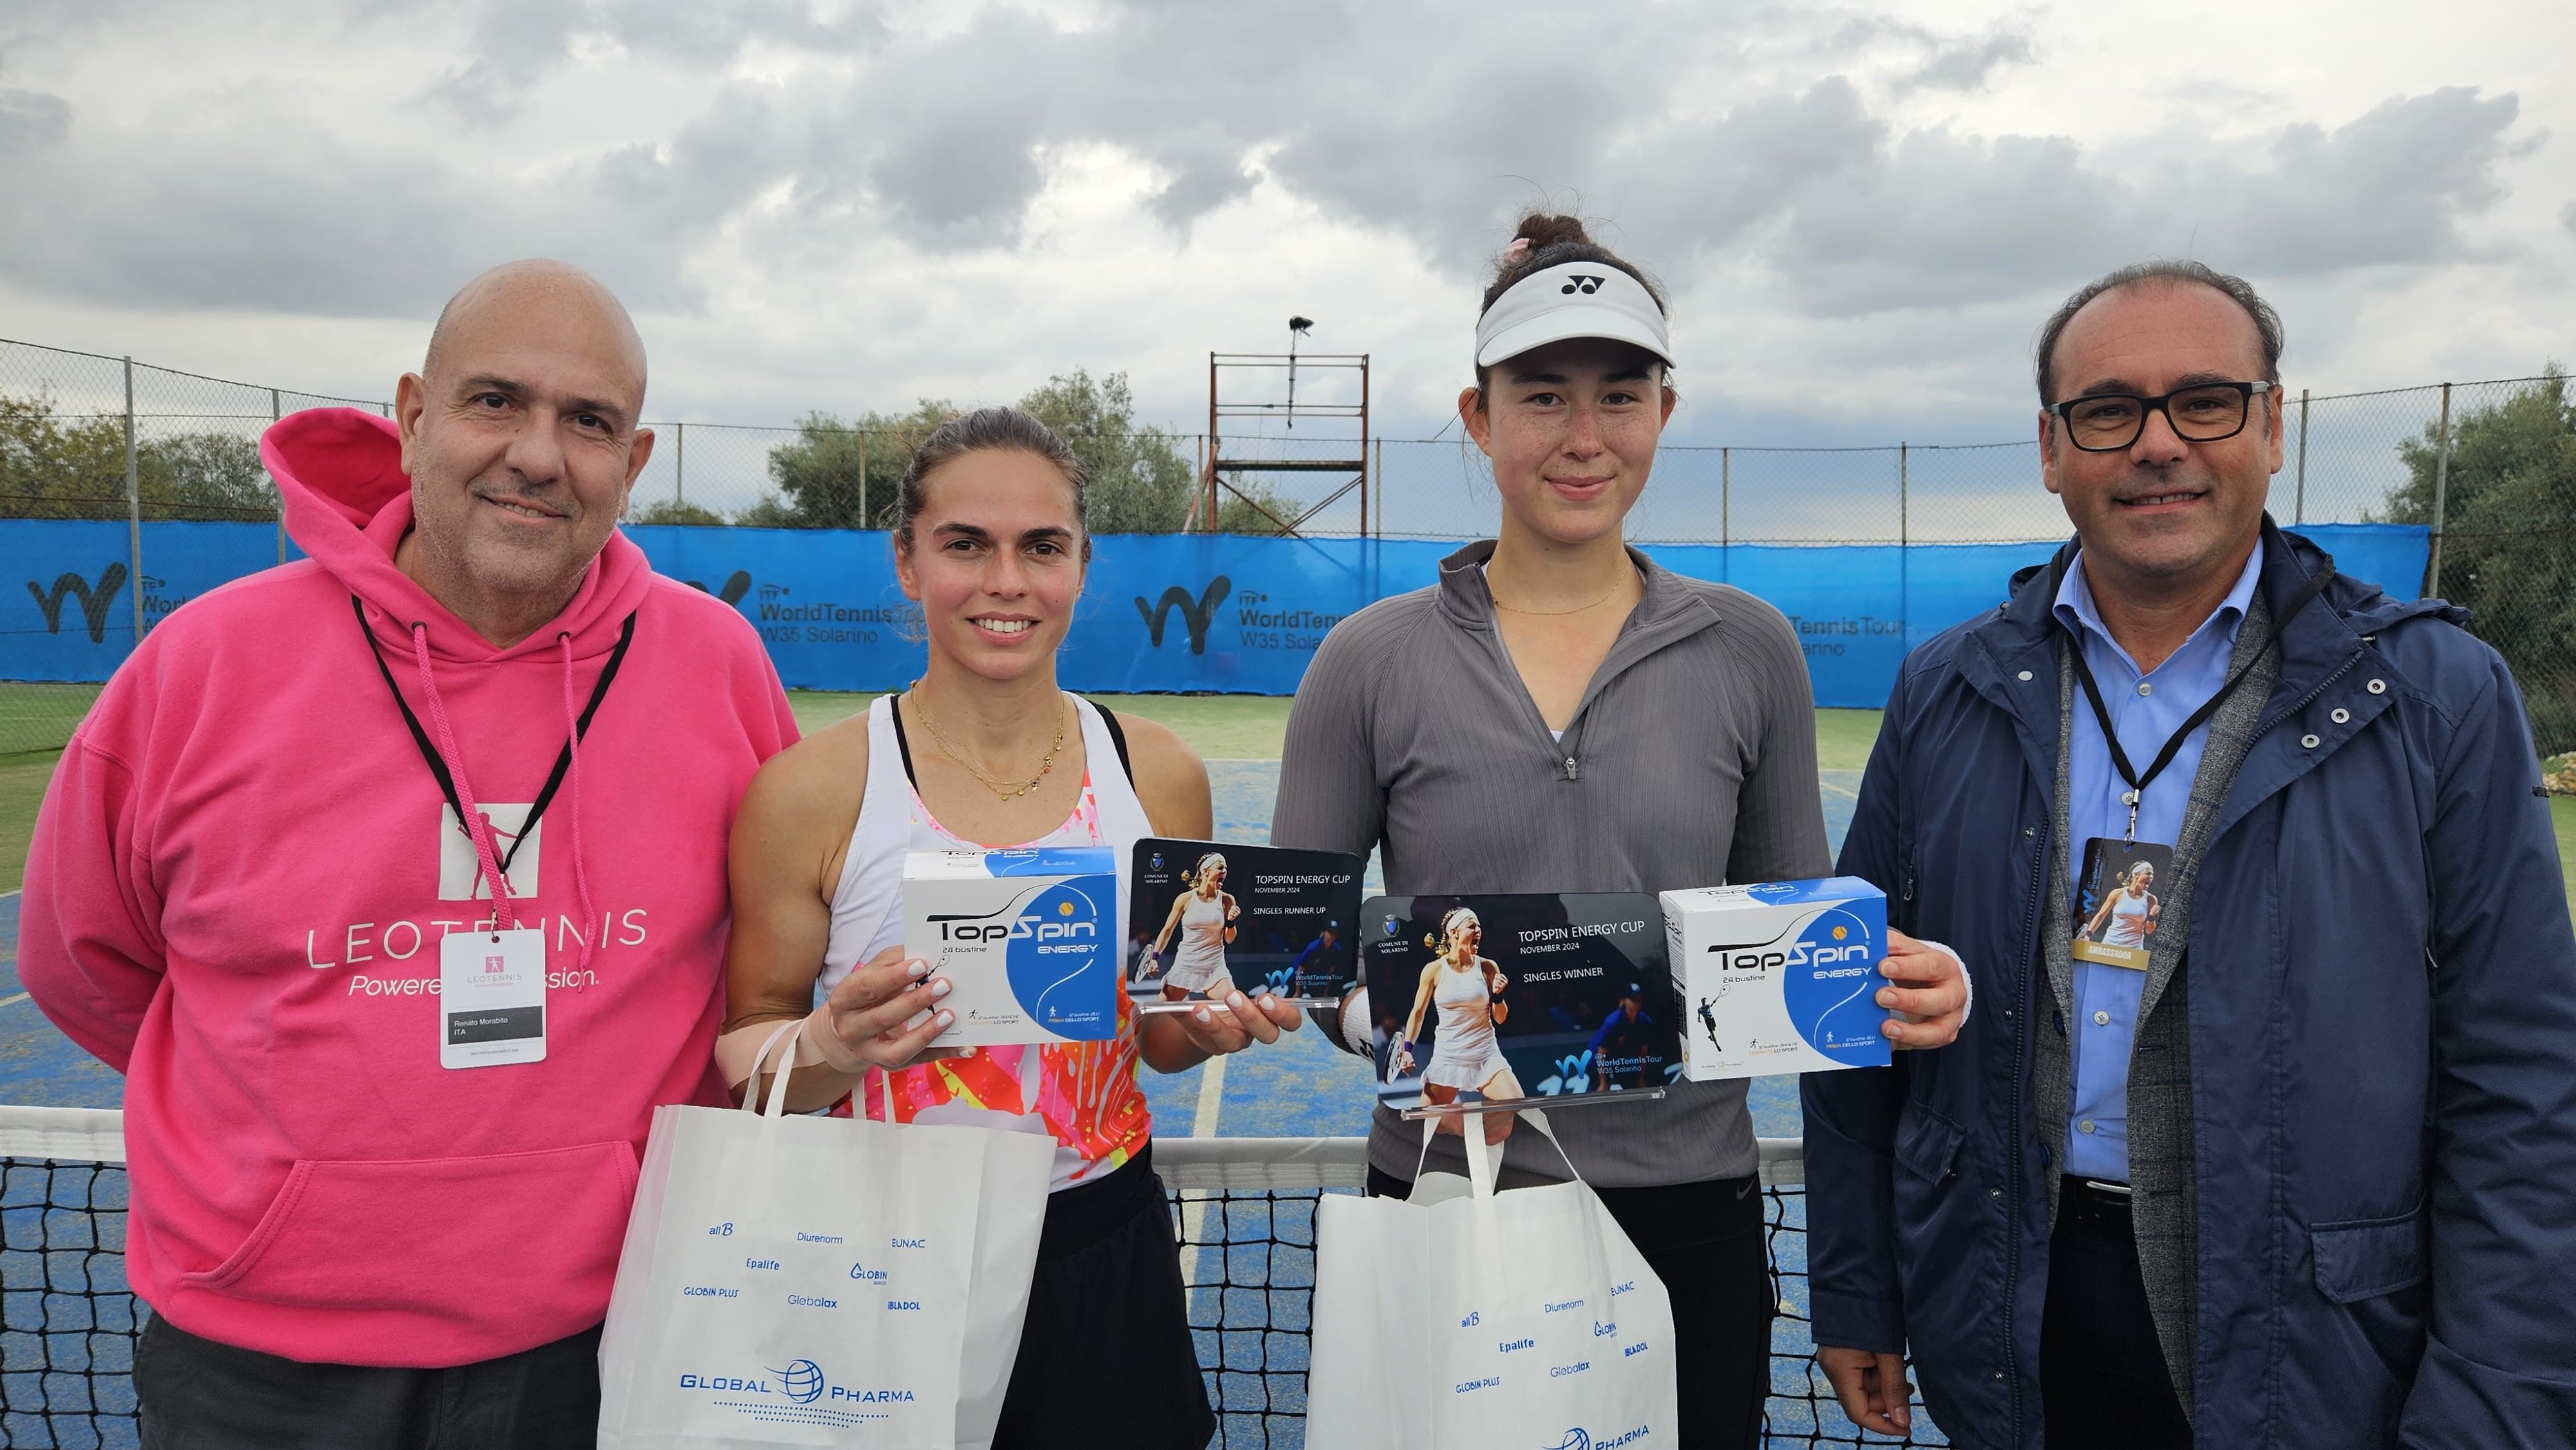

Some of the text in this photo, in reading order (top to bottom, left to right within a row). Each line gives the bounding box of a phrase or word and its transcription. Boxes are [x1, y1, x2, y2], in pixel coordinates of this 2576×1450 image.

[807, 625, 878, 643] Solarino
[1240, 631, 1323, 650] W35 Sola
[1803, 640, 1844, 657] arino
[1255, 874, 1350, 884] TOPSPIN ENERGY CUP
[927, 915, 1096, 943] TopSpin
[1518, 920, 1645, 943] TOPSPIN ENERGY CUP
[1037, 944, 1098, 954] ENERGY
[1520, 942, 1580, 954] NOVEMBER 2024
[2088, 945, 2132, 960] AMBASSADOR
[1707, 941, 1869, 972] TopSpin
[467, 973, 522, 983] LEOTENNIS
[1523, 966, 1604, 983] SINGLES WINNER
[1814, 967, 1871, 979] ENERGY
[348, 975, 441, 996] Powere
[1596, 1055, 1663, 1068] WorldTennisTour
[1597, 1066, 1642, 1075] W35 Solarino
[797, 1232, 843, 1245] Diurenorm
[891, 1238, 925, 1248] EUNAC
[746, 1258, 780, 1270] Epalife
[850, 1263, 887, 1279] GLOBIN
[684, 1286, 739, 1297] GLOBIN PLUS
[1611, 1281, 1634, 1296] EUNAC
[788, 1295, 837, 1308] Globalax
[1545, 1299, 1584, 1313] Diurenorm
[1499, 1339, 1535, 1353] Epalife
[1550, 1361, 1590, 1377] Globalax
[680, 1374, 914, 1402] GLOBAL PHARMA
[1456, 1377, 1500, 1393] GLOBIN PLUS
[1596, 1424, 1649, 1450] PHARMA
